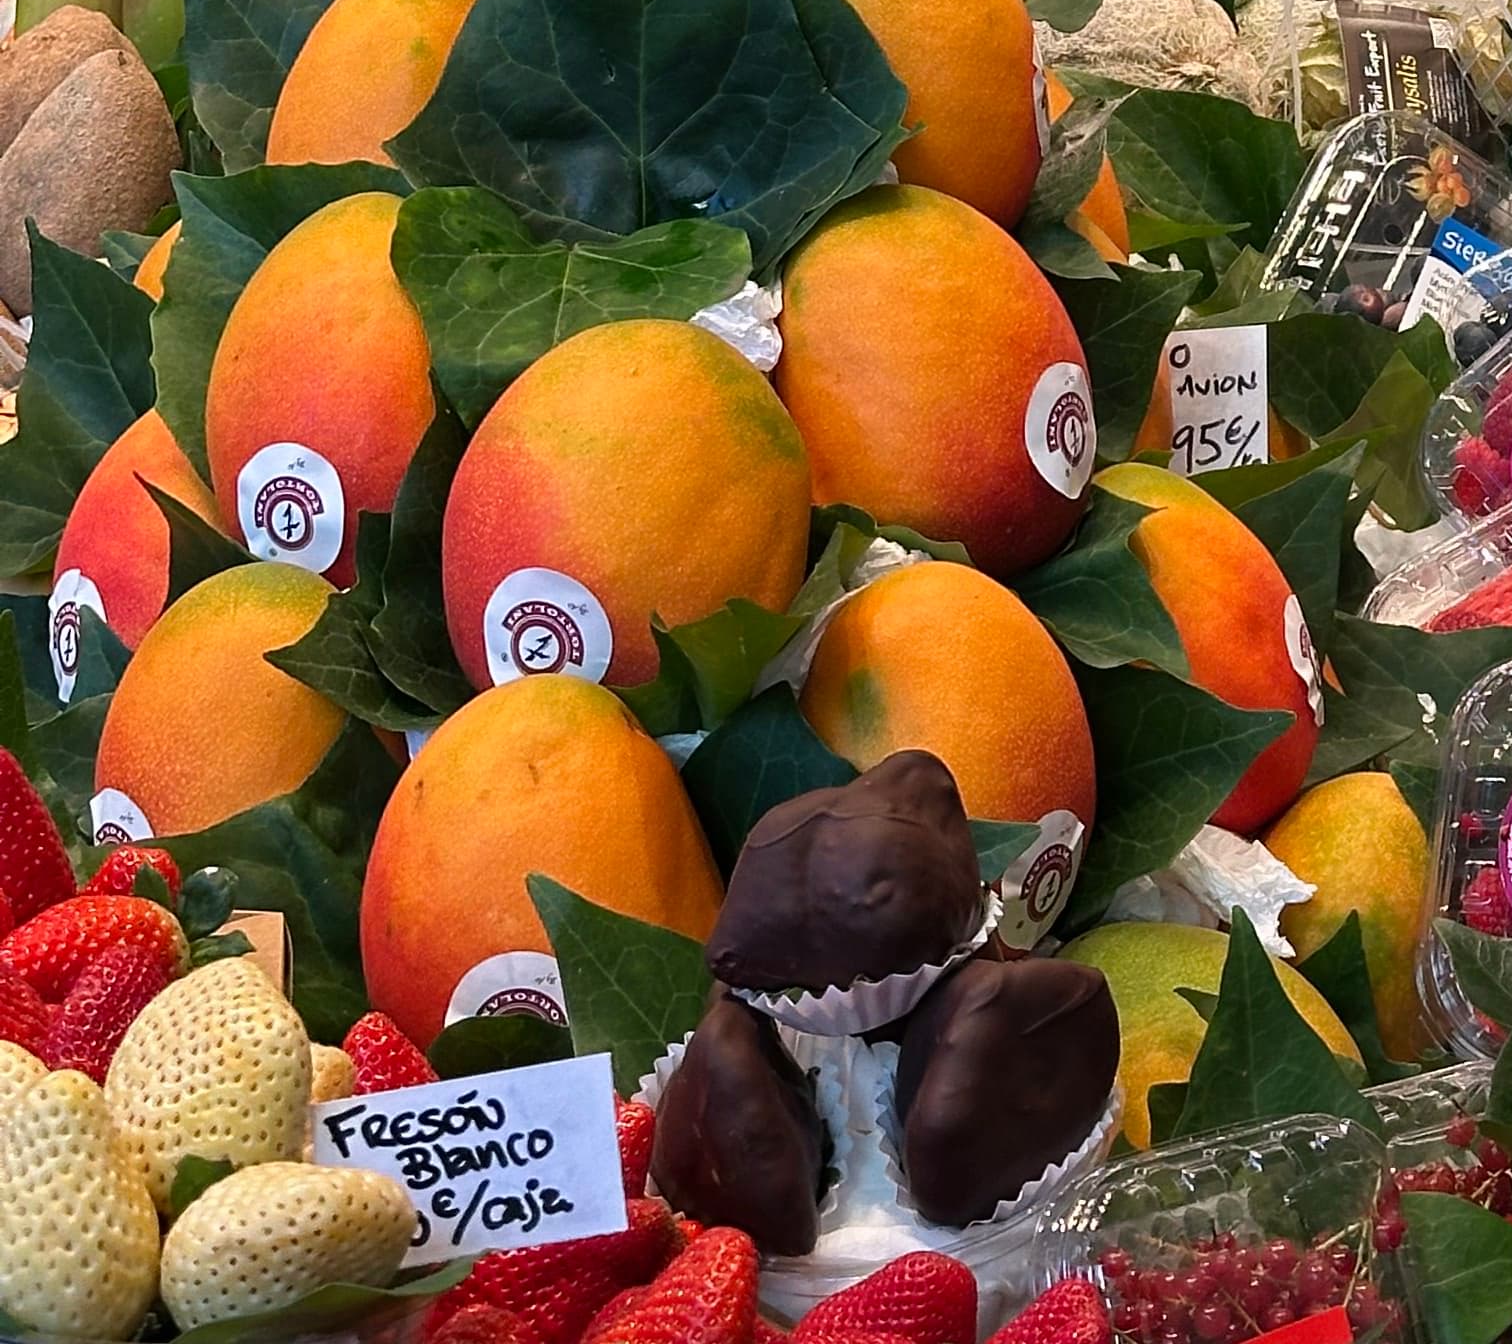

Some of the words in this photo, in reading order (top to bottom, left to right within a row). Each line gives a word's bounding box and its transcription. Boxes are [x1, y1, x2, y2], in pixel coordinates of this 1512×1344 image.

[1395, 54, 1429, 115] ysalis
[507, 604, 580, 660] TORTOLANI
[395, 1128, 555, 1190] Blanco
